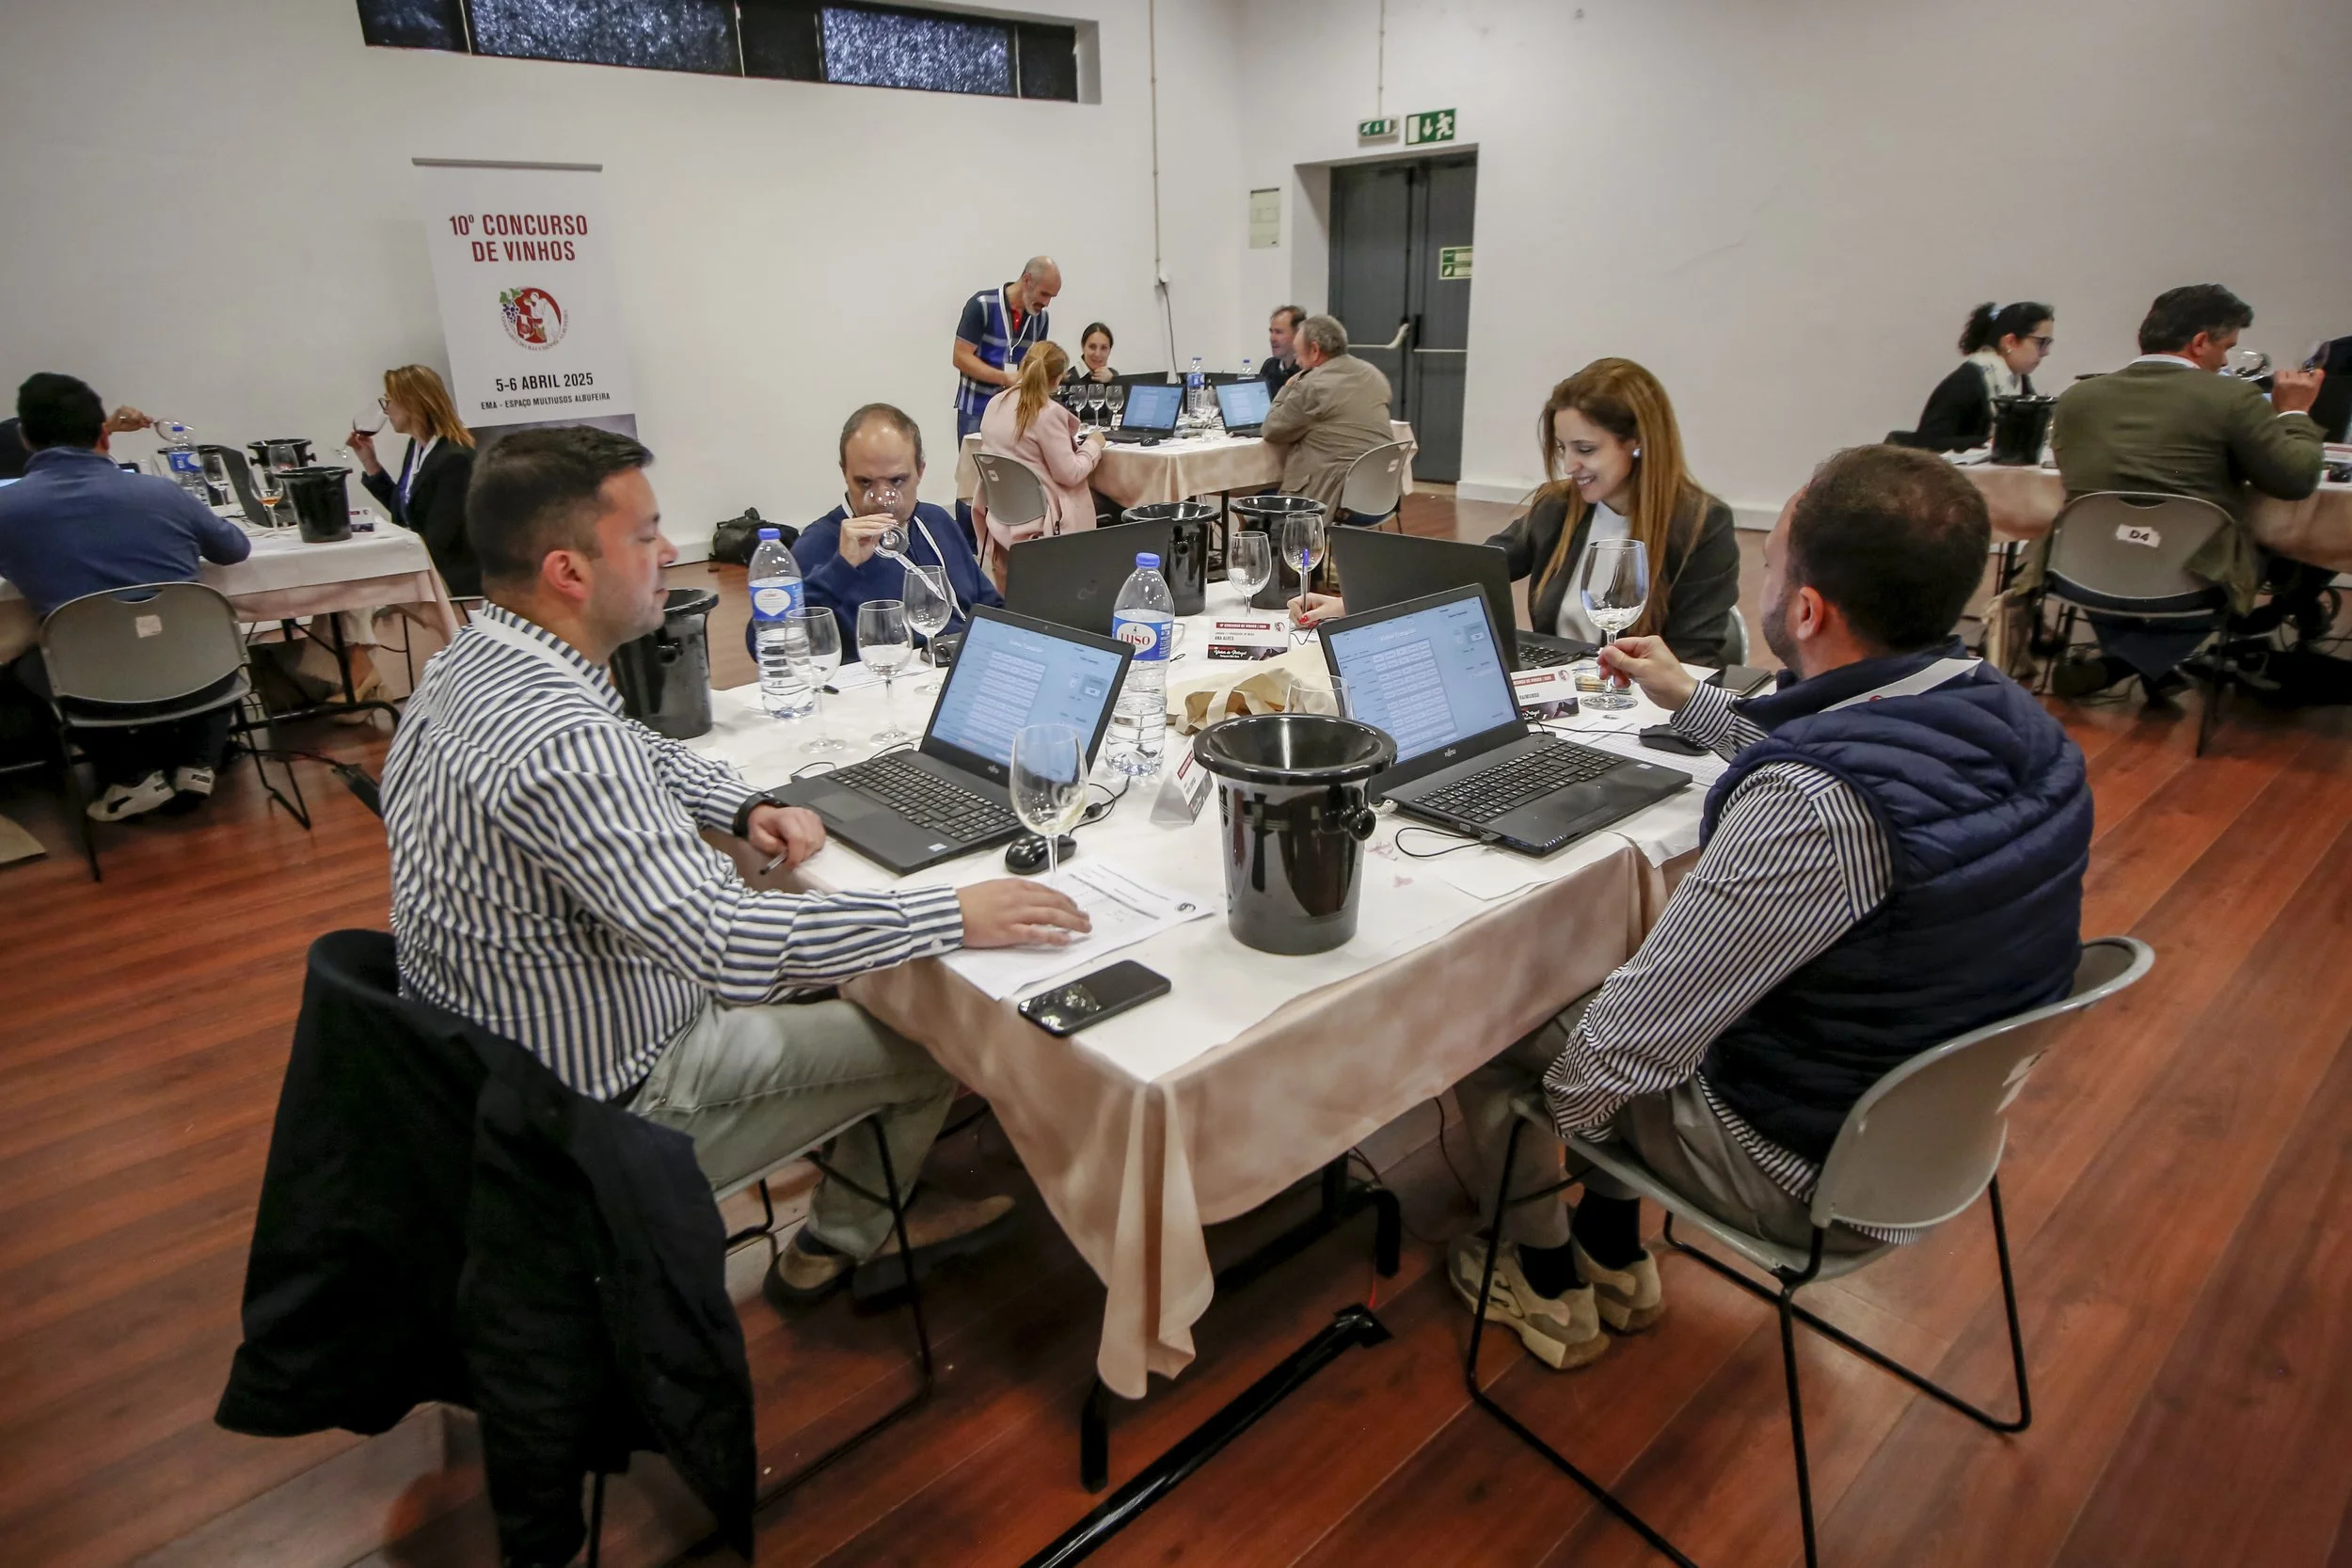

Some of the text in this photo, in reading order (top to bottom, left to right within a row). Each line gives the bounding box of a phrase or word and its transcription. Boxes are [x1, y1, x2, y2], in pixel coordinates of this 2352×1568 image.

[482, 214, 589, 236] CONCURSO
[471, 240, 576, 262] DE VINHOS
[495, 372, 595, 392] 5-6 ABRIL 2025
[480, 401, 498, 410] EMA
[504, 398, 532, 409] ESPAÇO
[532, 394, 573, 406] MULTIUSOS
[574, 391, 611, 403] ALBUFEIRA
